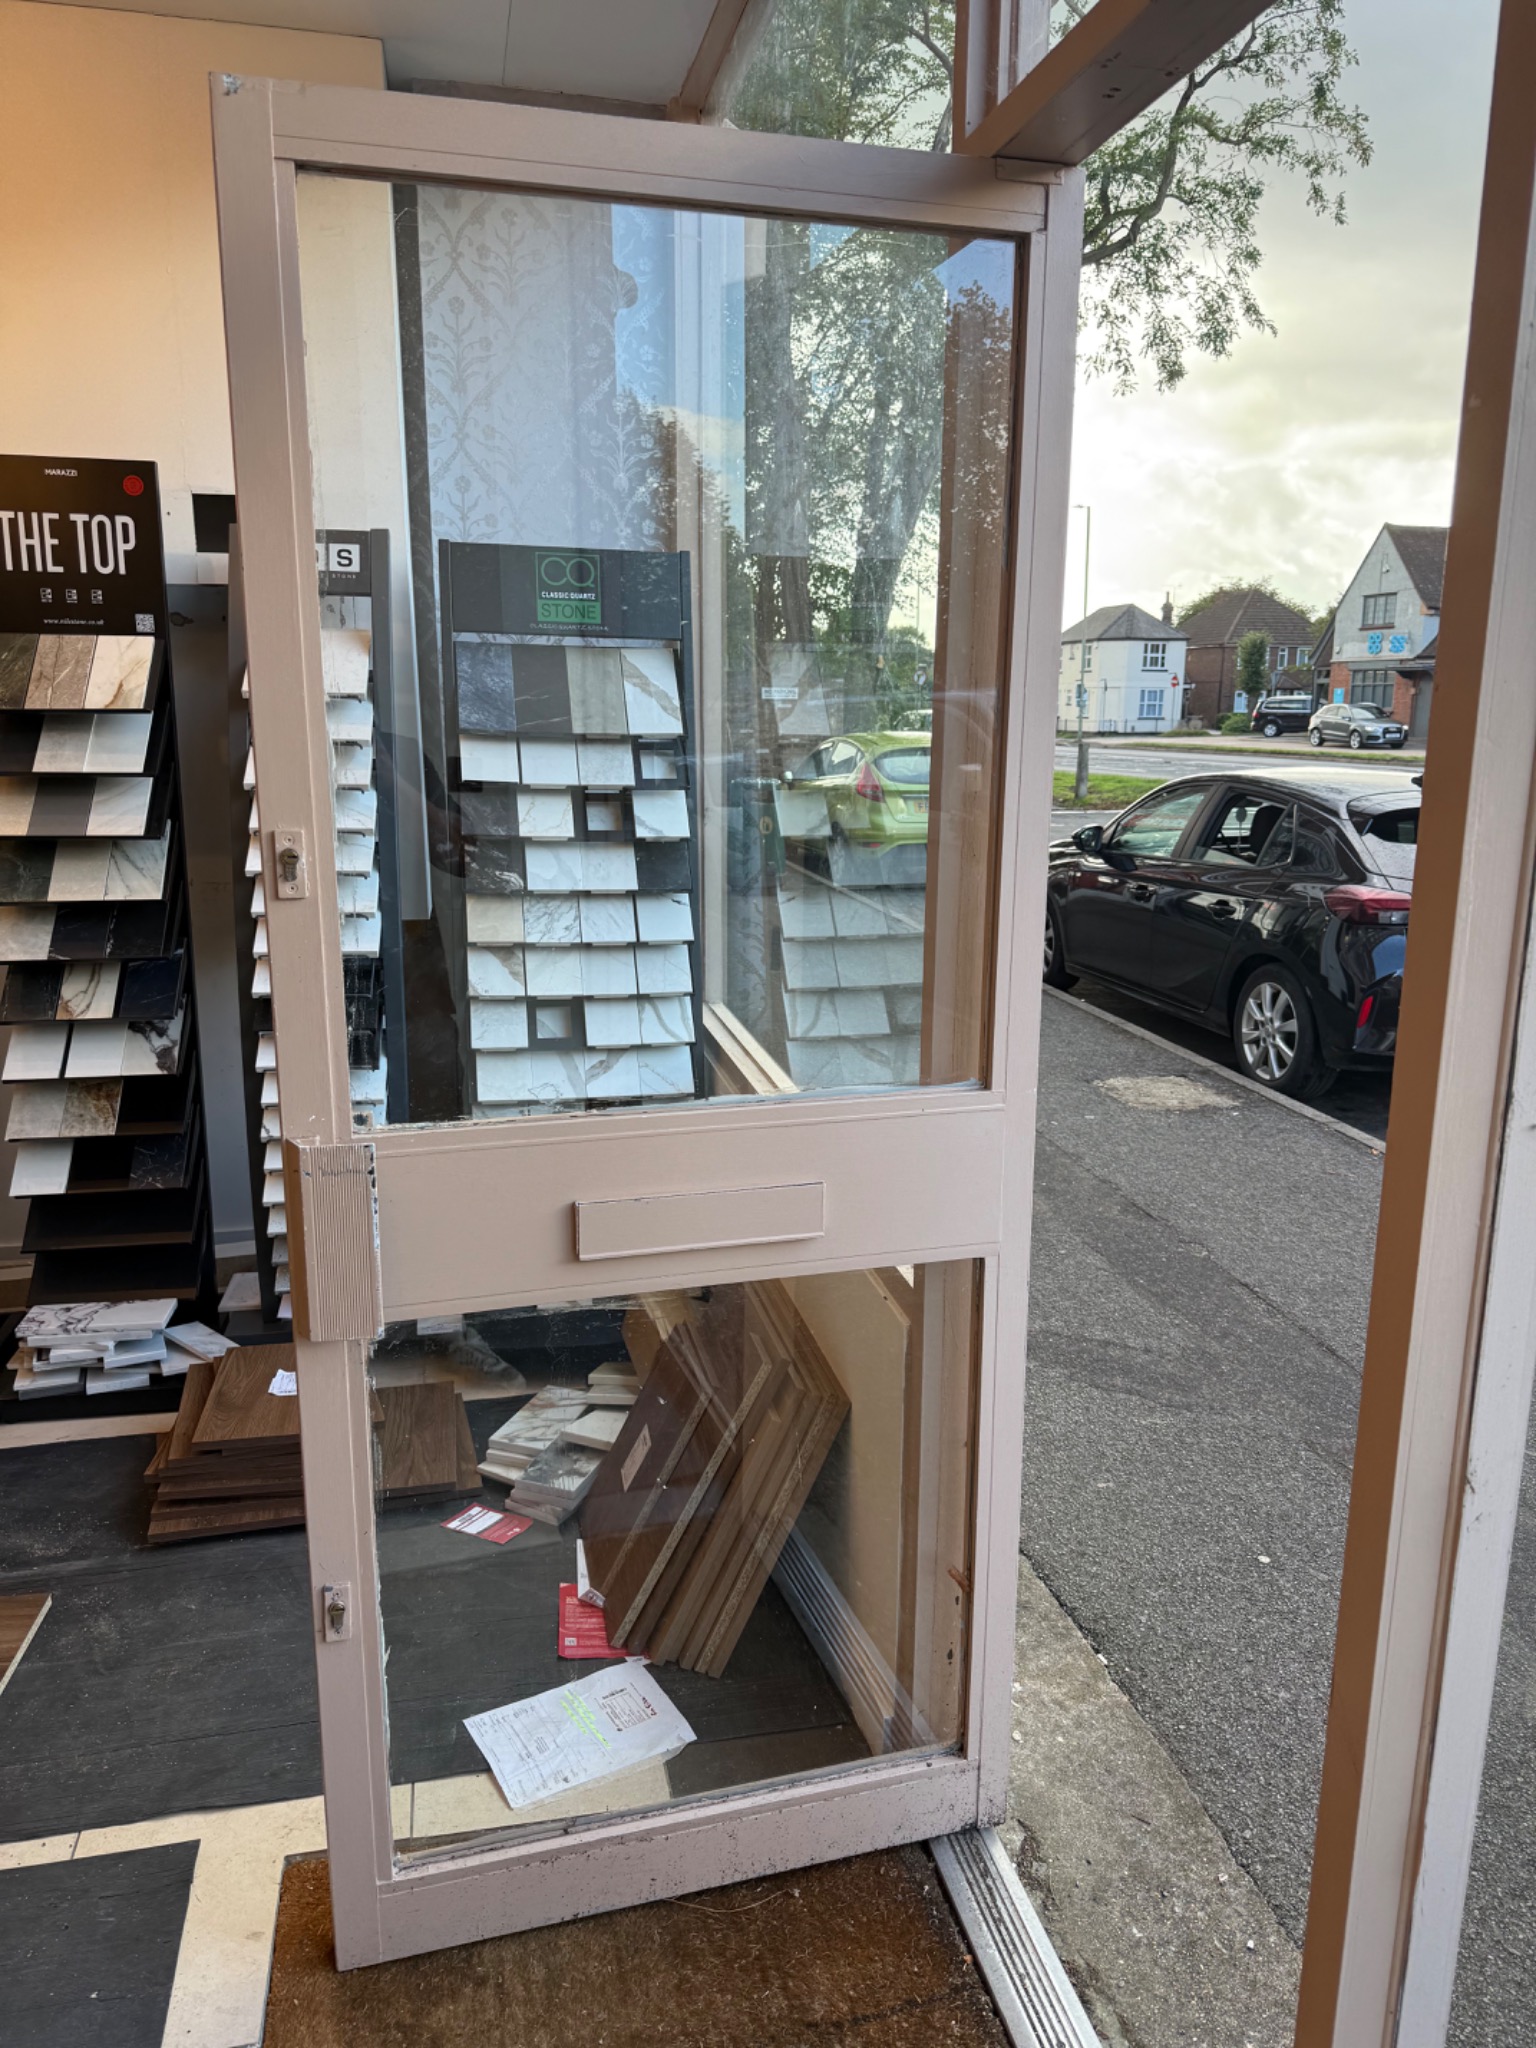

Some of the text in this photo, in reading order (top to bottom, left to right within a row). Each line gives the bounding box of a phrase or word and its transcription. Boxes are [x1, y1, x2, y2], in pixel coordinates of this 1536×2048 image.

[44, 468, 78, 477] MARAZZI
[0, 511, 136, 575] THE TOP
[337, 548, 354, 568] S
[541, 557, 595, 588] CQ
[541, 591, 597, 600] CLASSIC QUARTZ
[541, 603, 597, 620] STONE
